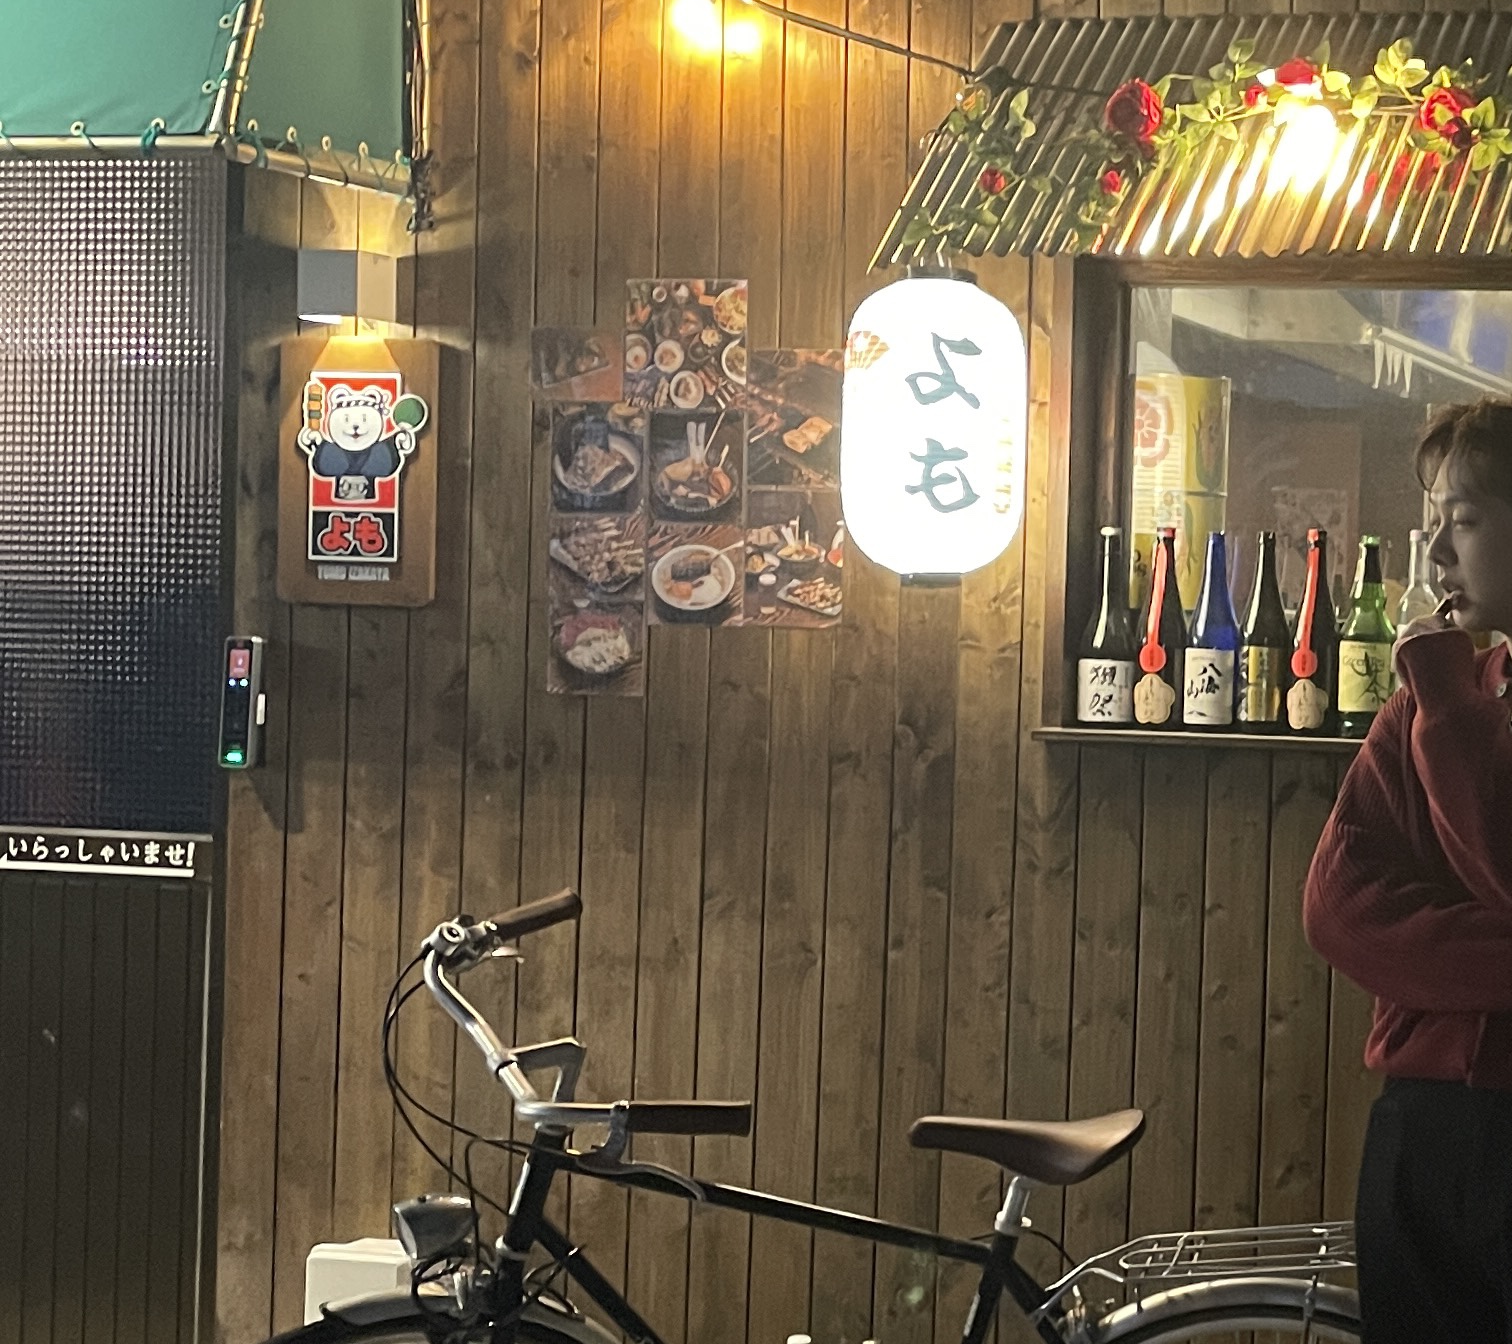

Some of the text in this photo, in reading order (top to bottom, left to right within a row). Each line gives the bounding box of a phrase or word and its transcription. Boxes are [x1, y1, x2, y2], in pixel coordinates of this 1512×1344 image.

[904, 331, 983, 514] よも
[317, 512, 388, 557] よも
[8, 835, 196, 868] いらっしゃいませ!
